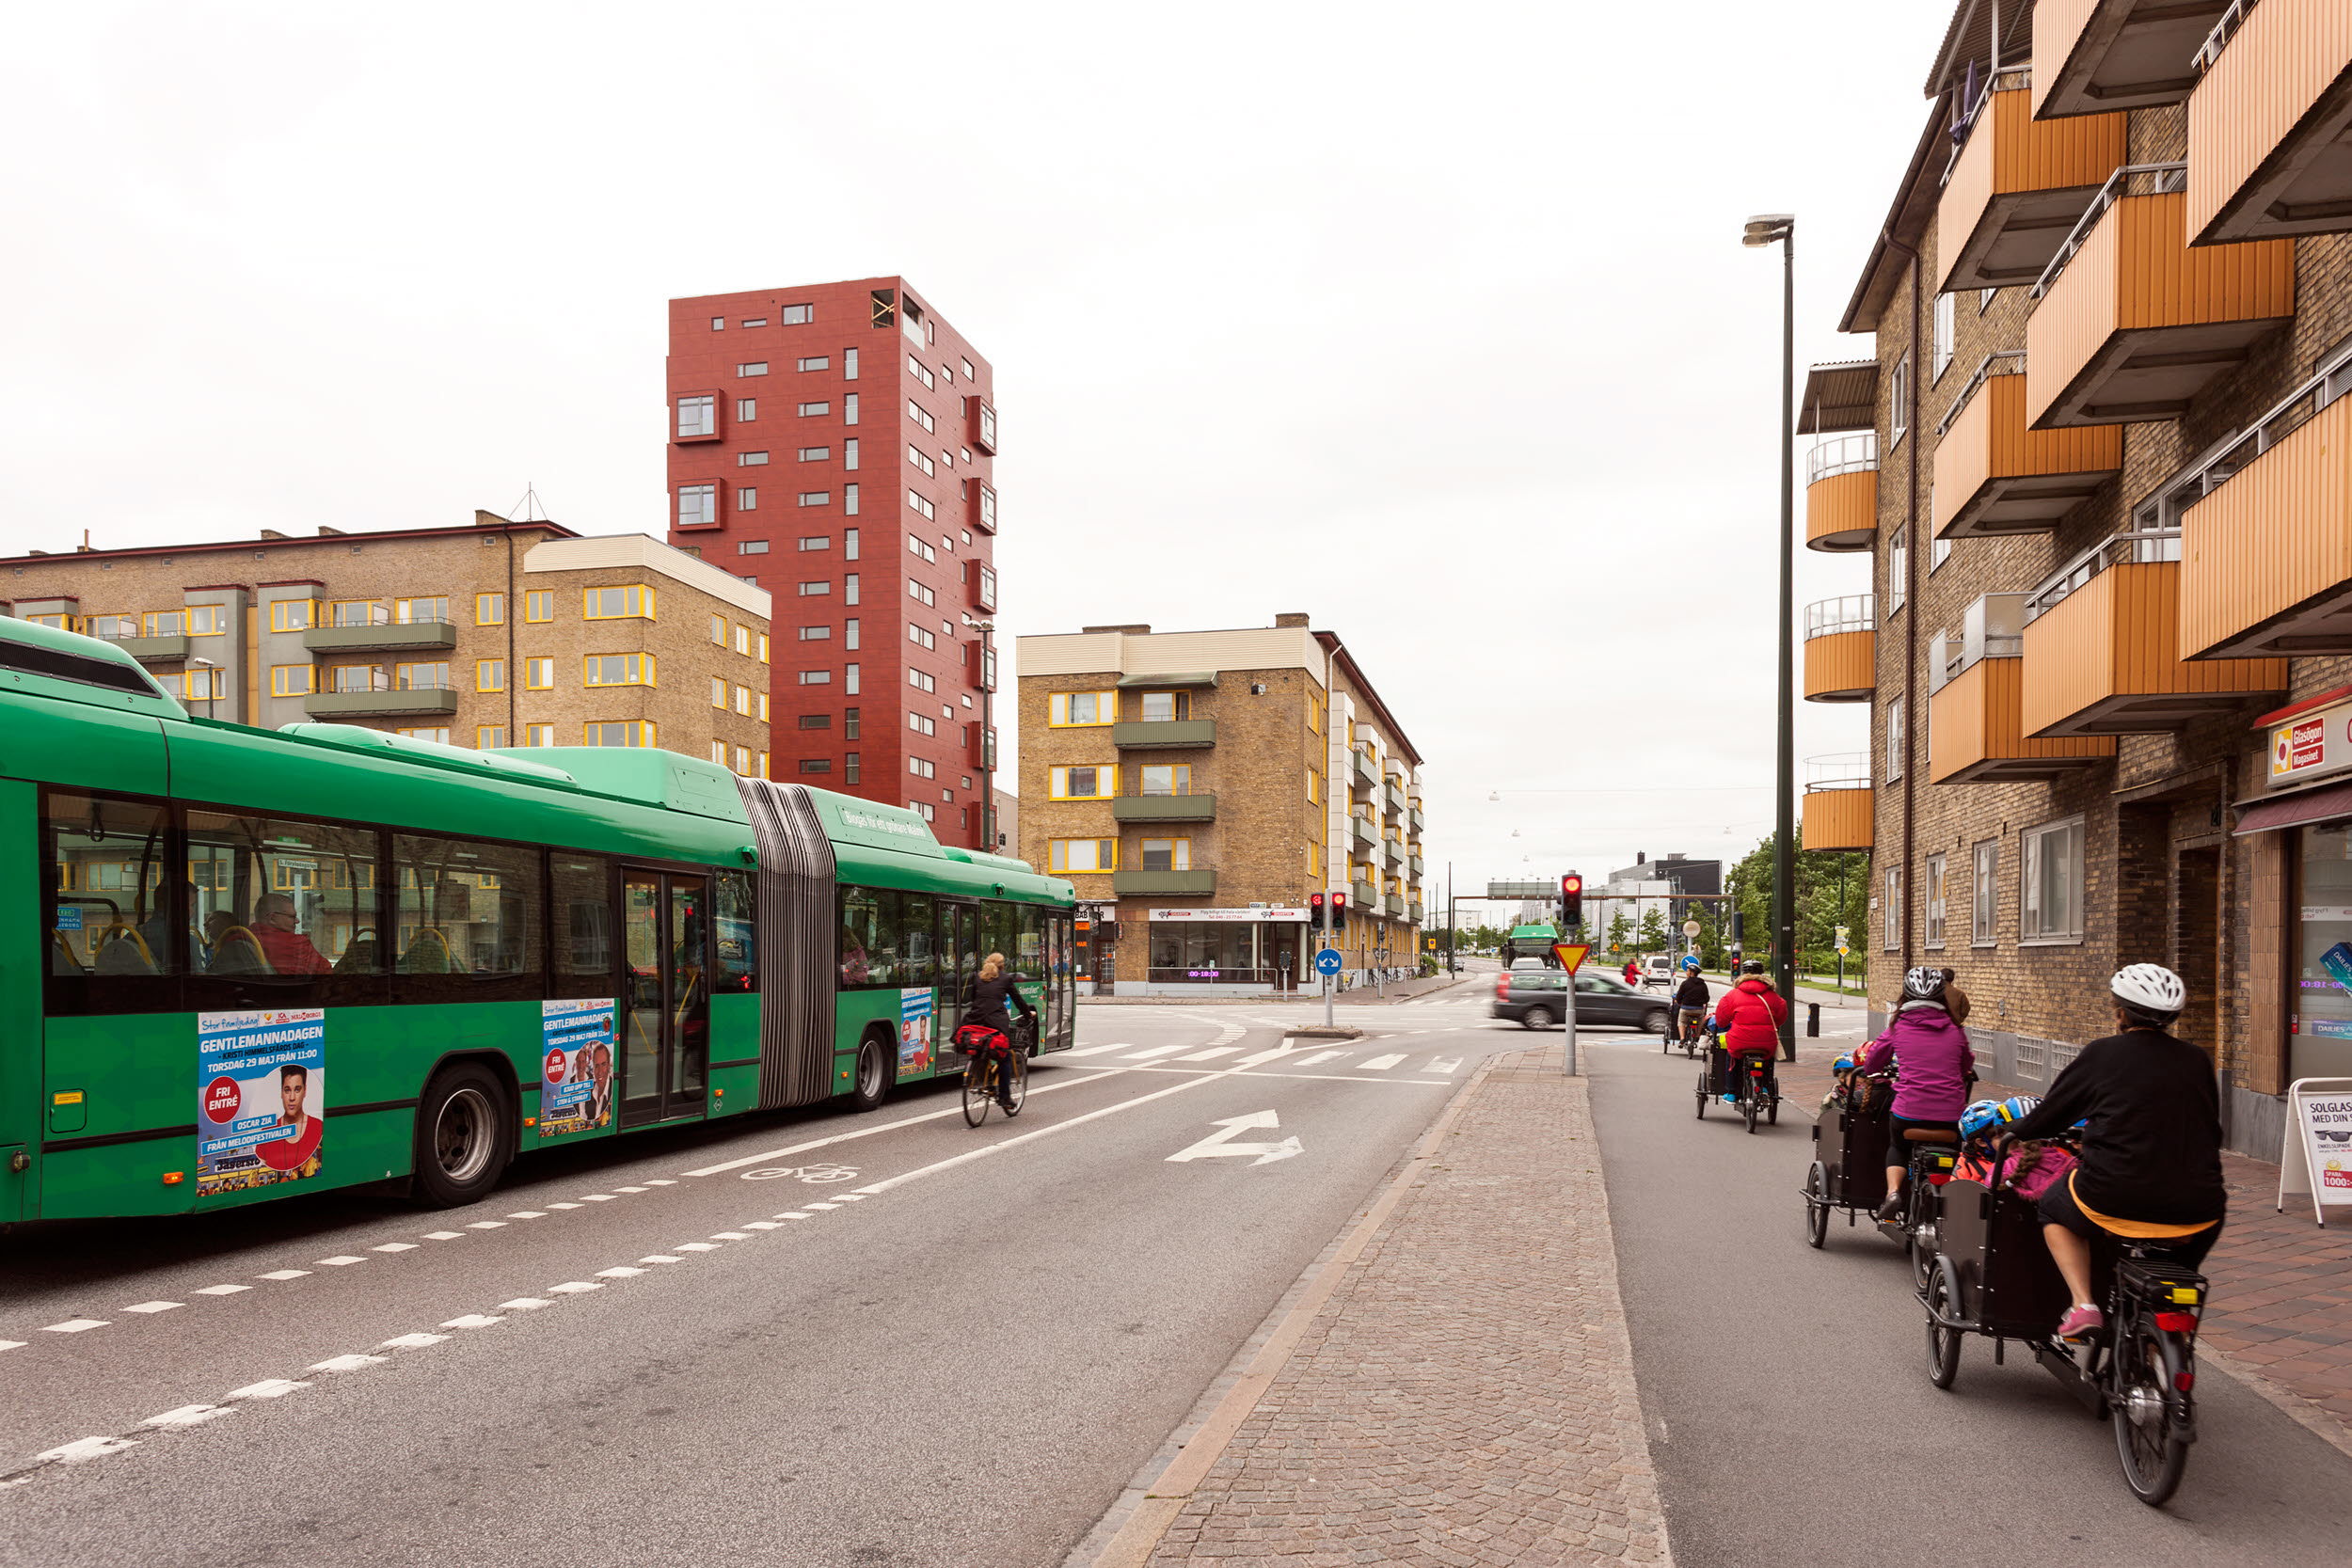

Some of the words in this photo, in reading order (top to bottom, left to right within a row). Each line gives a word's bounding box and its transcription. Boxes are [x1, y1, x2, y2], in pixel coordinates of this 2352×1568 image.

[2293, 726, 2322, 745] Glasögon
[2293, 750, 2318, 766] Magasinet
[2333, 951, 2352, 974] DAILIES
[201, 1019, 219, 1031] Stor
[2318, 1025, 2344, 1034] DAILIES
[200, 1026, 323, 1053] GENTLEMANNADAGEN
[222, 1050, 244, 1060] KRISTI
[293, 1041, 305, 1050] DAG
[207, 1060, 245, 1073] TORSDAG
[246, 1058, 257, 1068] 29
[258, 1055, 275, 1066] MAJ
[276, 1053, 296, 1063] FRÅN
[297, 1050, 318, 1059] 11:00
[548, 1063, 564, 1073] ENTRÉ
[215, 1086, 230, 1098] FRI
[209, 1094, 238, 1110] ENTRÉ
[237, 1118, 260, 1131] OSCAR
[261, 1117, 272, 1126] ZIA
[207, 1141, 227, 1152] FRÅN
[228, 1127, 292, 1148] MELODIFESTIVALEN
